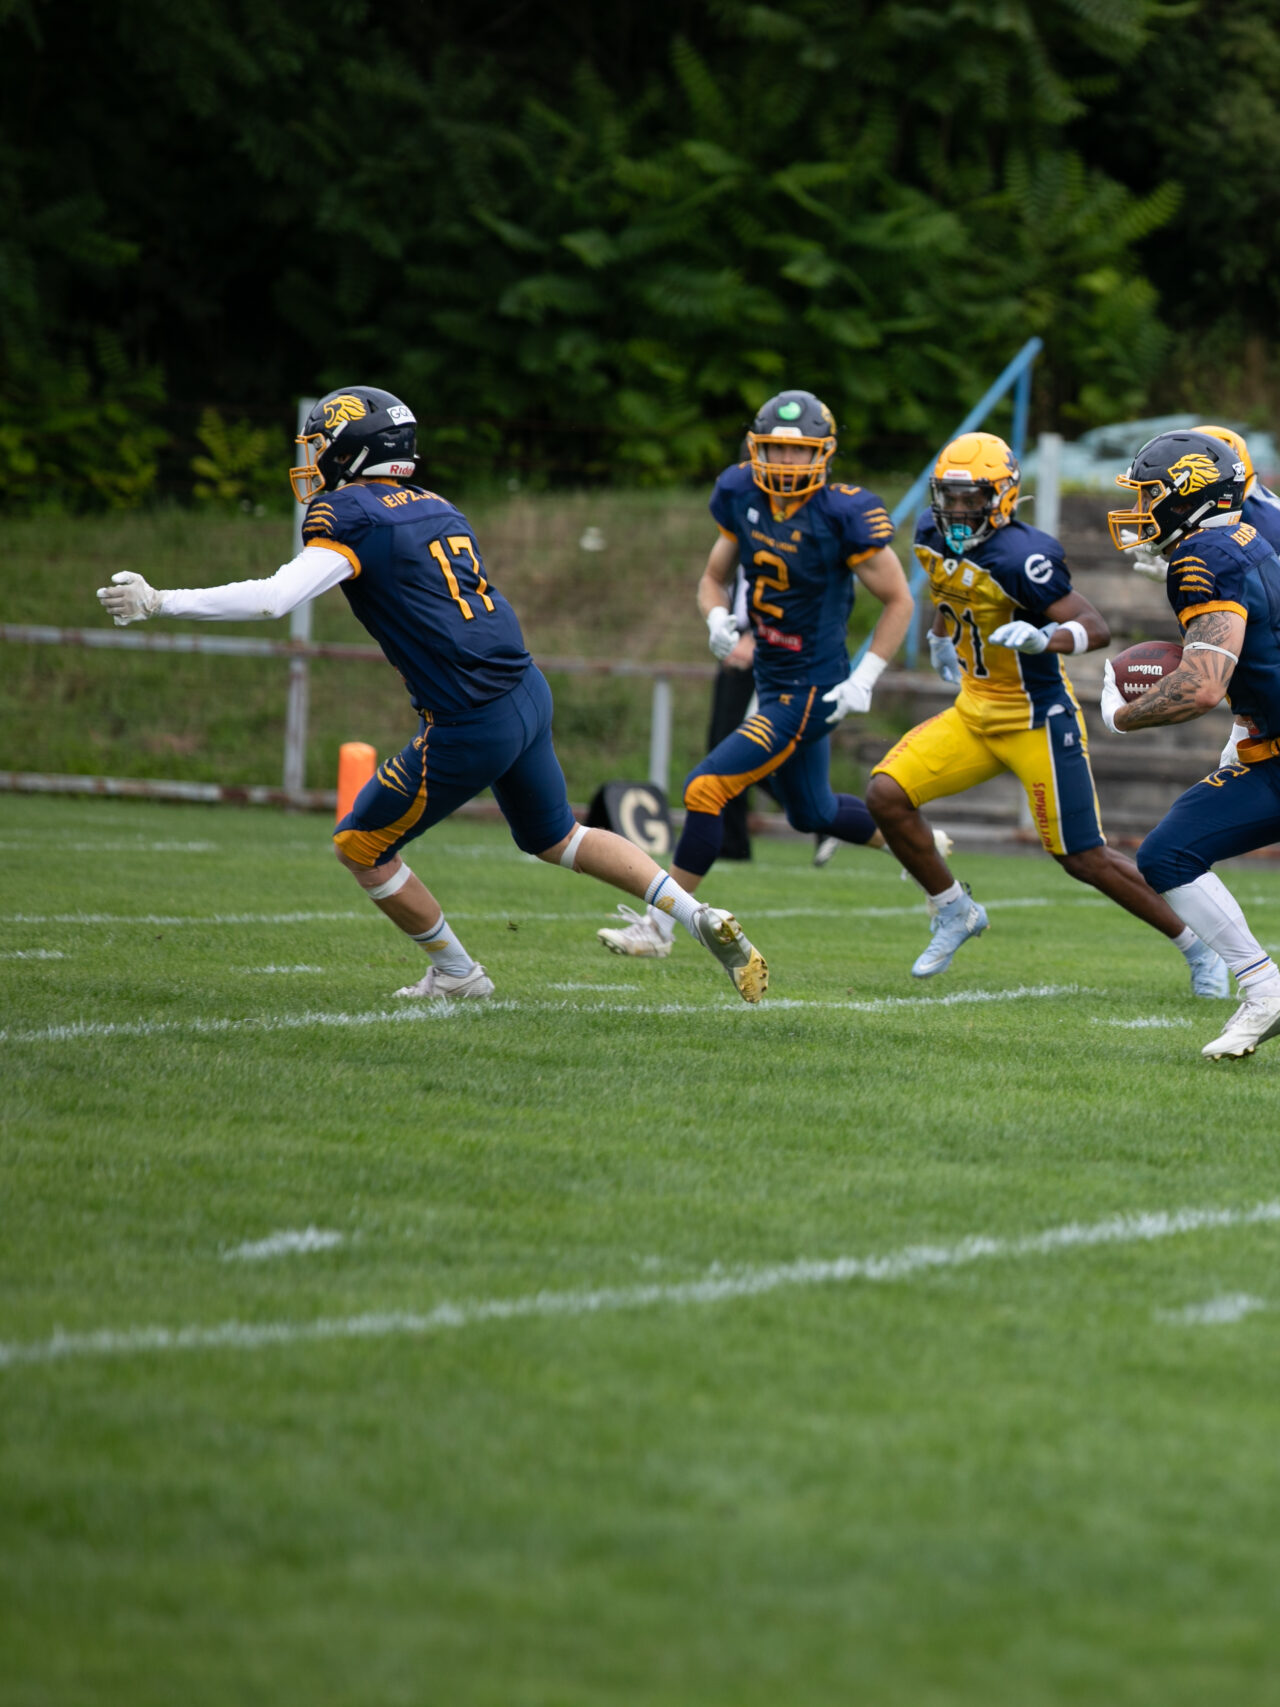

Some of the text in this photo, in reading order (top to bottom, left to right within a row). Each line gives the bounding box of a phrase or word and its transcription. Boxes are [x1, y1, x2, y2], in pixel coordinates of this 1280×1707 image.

[428, 534, 497, 622] 17
[753, 549, 791, 620] 2
[1127, 664, 1163, 677] Wilson
[618, 787, 672, 852] G
